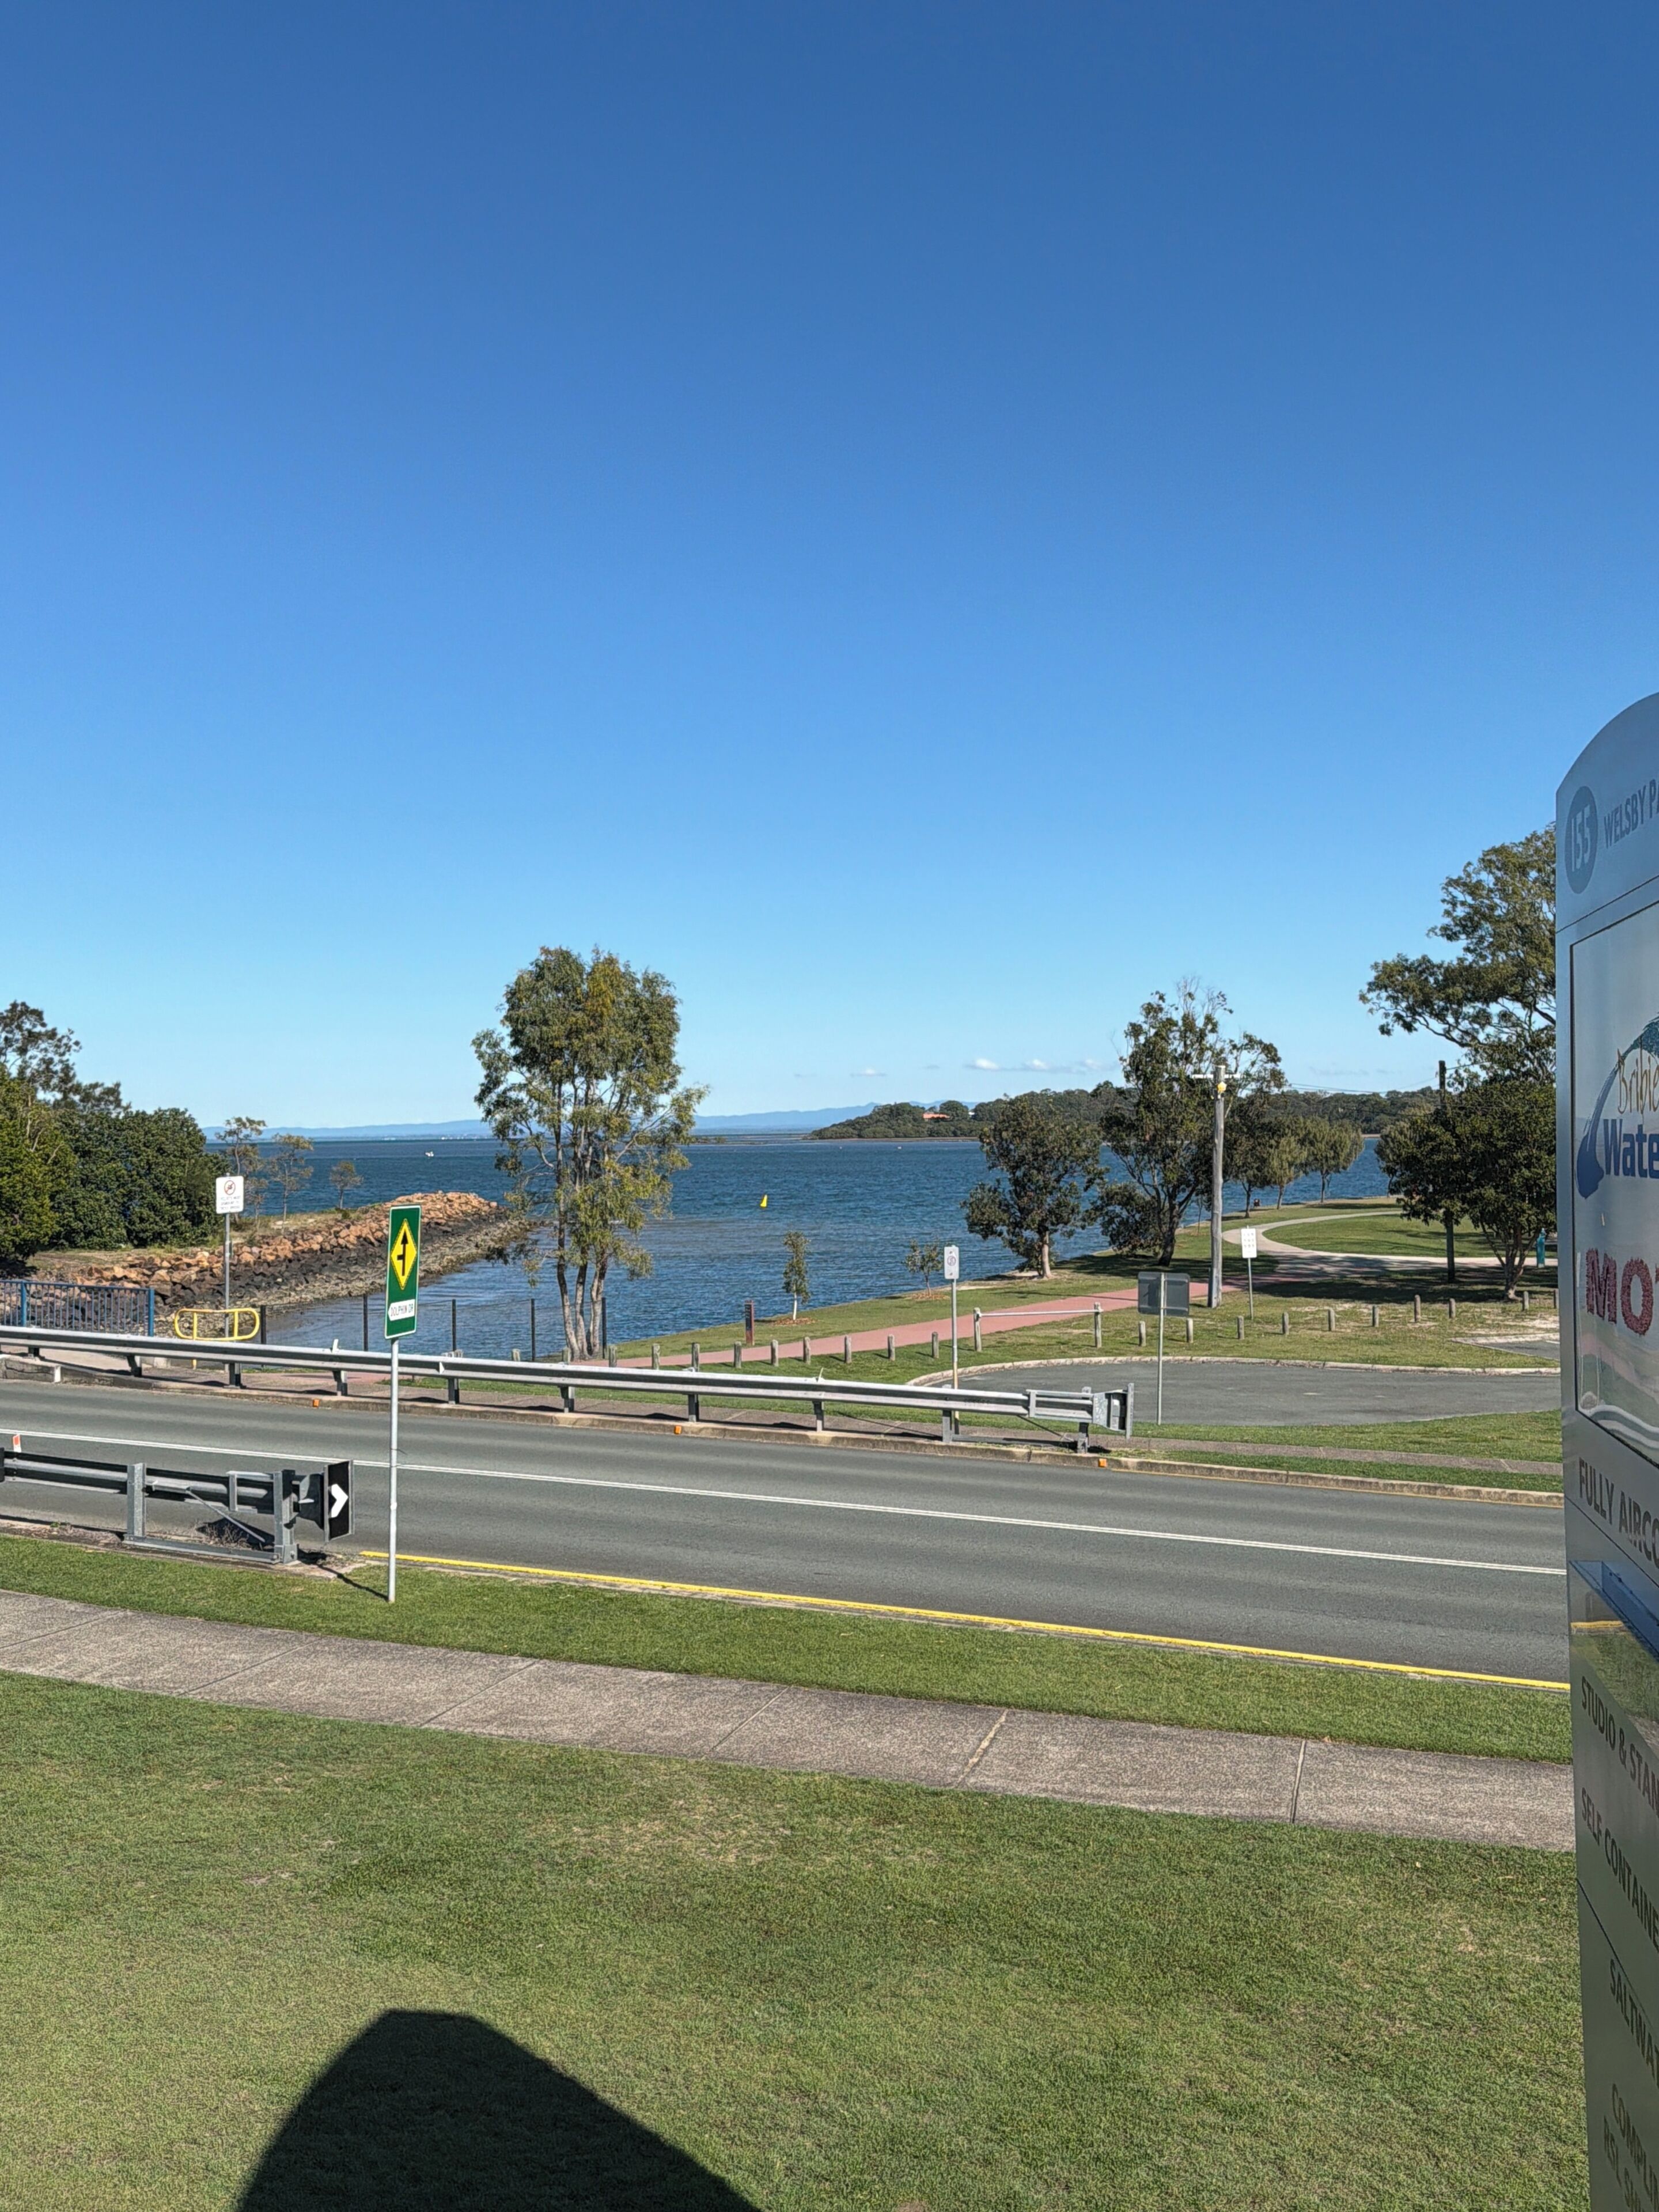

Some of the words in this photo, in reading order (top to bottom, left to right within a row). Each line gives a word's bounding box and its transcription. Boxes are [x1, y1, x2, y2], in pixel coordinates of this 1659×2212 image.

[1571, 804, 1590, 872] 155
[1604, 785, 1646, 849] WELSBY
[1603, 1118, 1659, 1179] Wate
[1586, 1247, 1659, 1336] MO
[1579, 1457, 1614, 1525] FULLY
[1581, 1675, 1616, 1751] STUDIO
[1619, 1727, 1627, 1768] &
[1581, 1787, 1602, 1847] SELF
